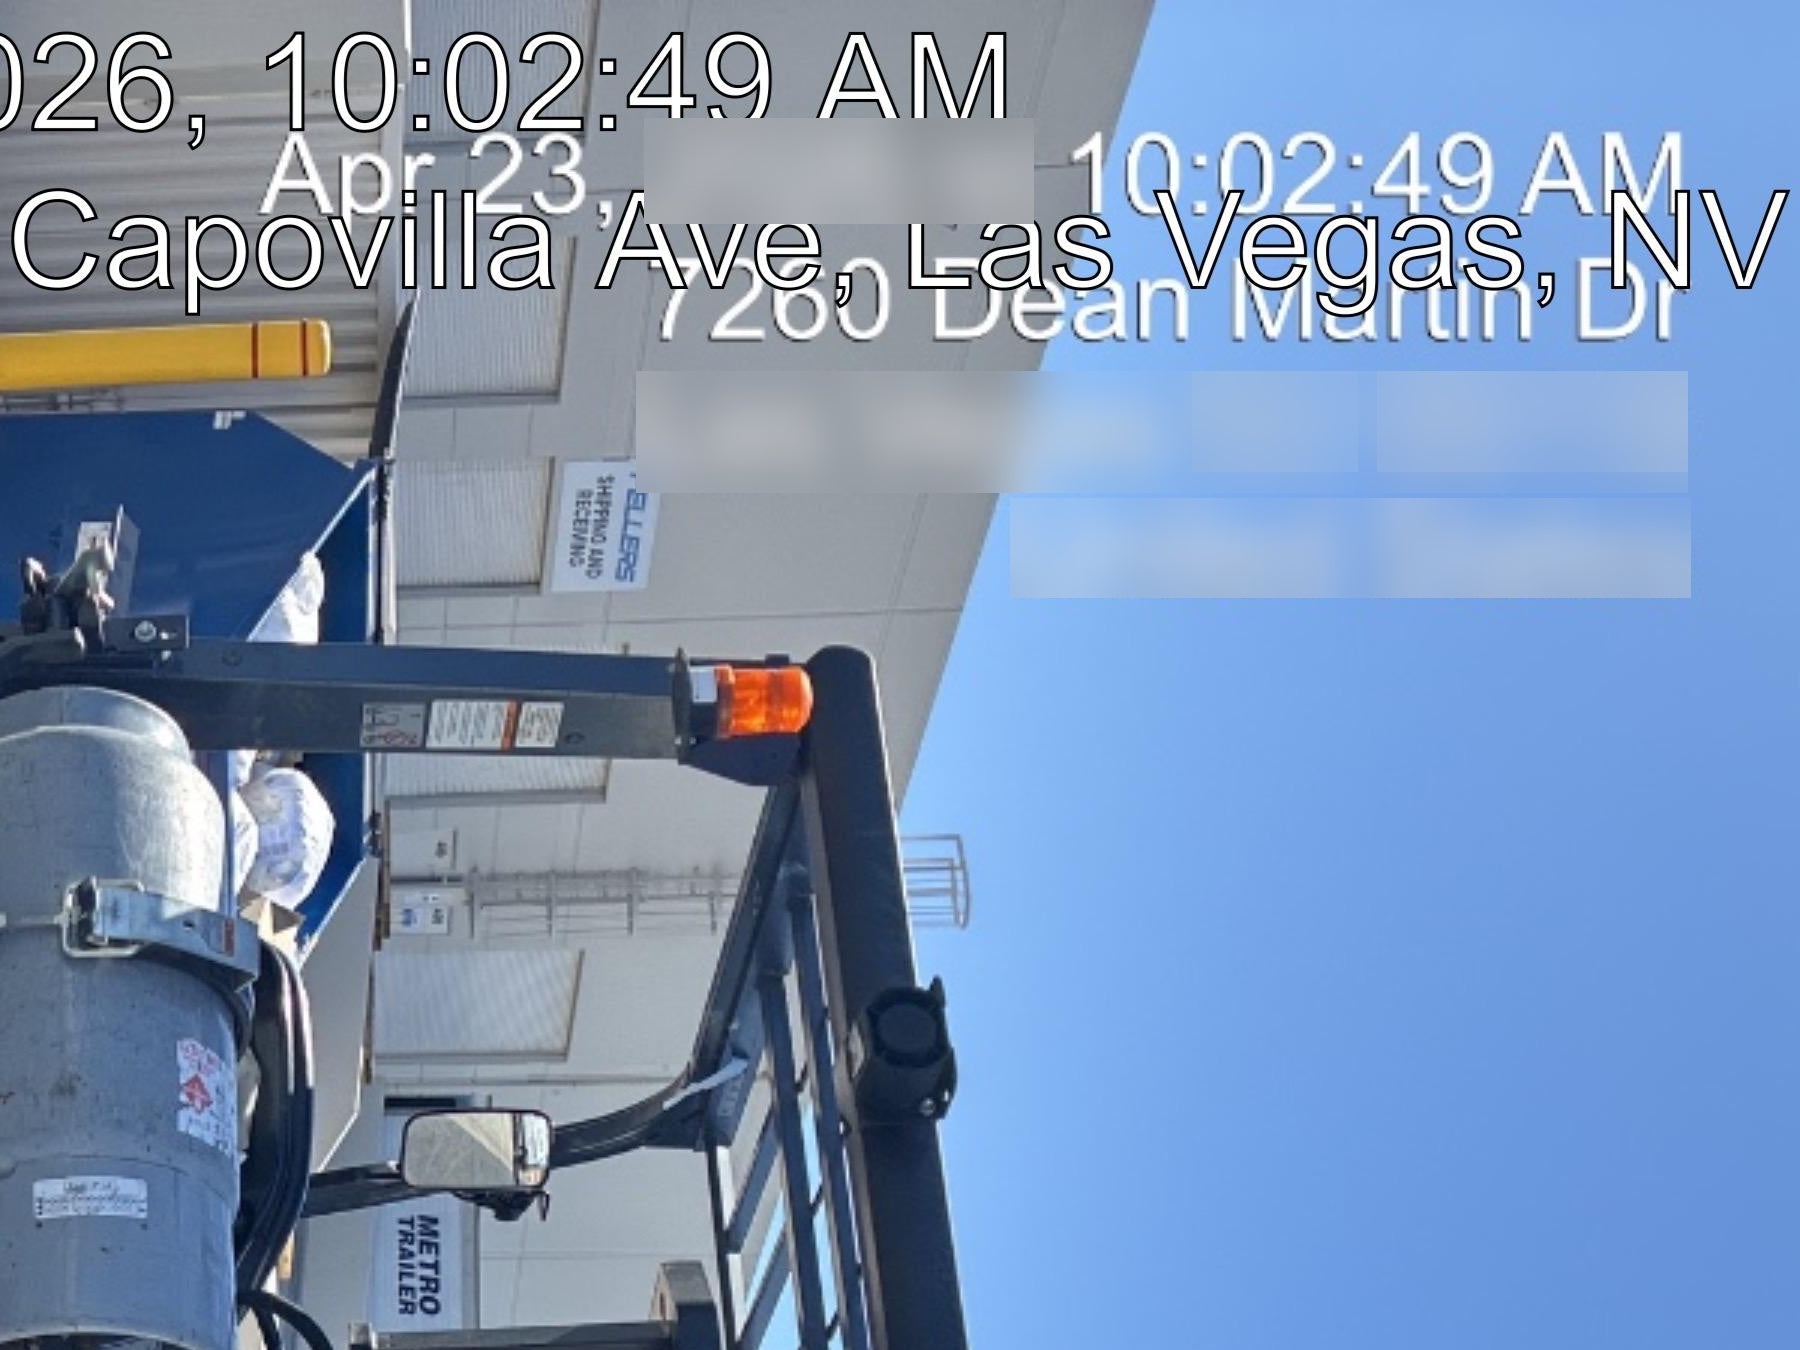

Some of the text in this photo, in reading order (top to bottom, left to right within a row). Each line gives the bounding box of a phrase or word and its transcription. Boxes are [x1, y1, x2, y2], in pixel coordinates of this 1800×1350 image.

[568, 489, 594, 569] RECEIVING
[585, 474, 616, 580] SHIPPING AND
[614, 472, 647, 583] ELLERS
[398, 1215, 416, 1315] TRAILER
[418, 1215, 441, 1315] METRO
